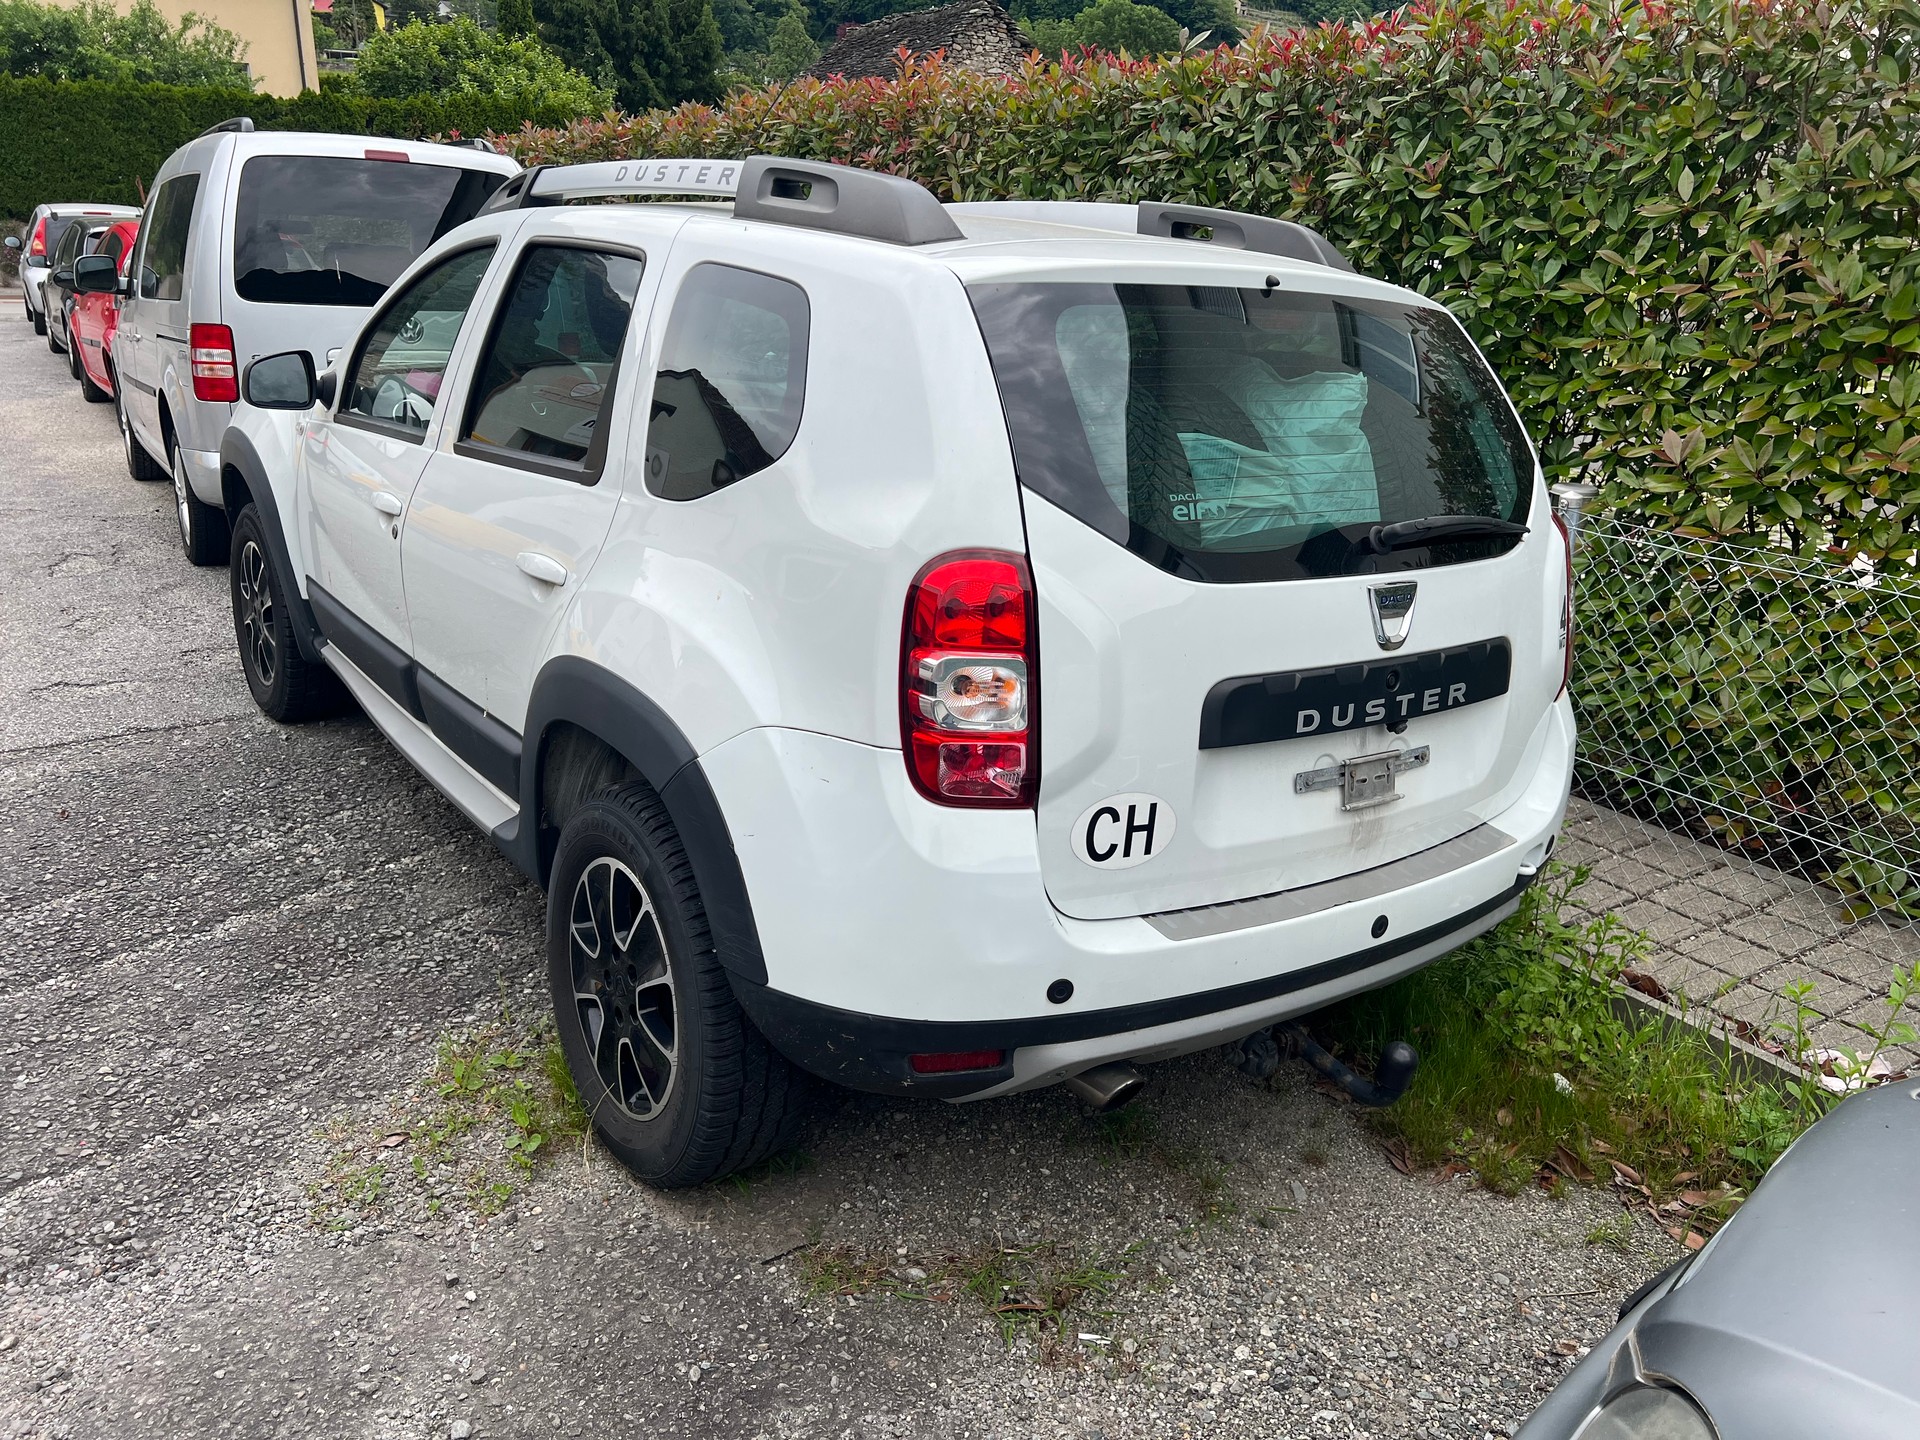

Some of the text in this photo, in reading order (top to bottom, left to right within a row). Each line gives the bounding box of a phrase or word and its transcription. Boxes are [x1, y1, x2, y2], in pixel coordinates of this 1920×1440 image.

[615, 165, 735, 185] DUSTER
[1169, 493, 1204, 502] DACIA
[1381, 593, 1413, 605] DACIA
[1296, 682, 1467, 734] DUSTER
[1086, 802, 1157, 862] CH
